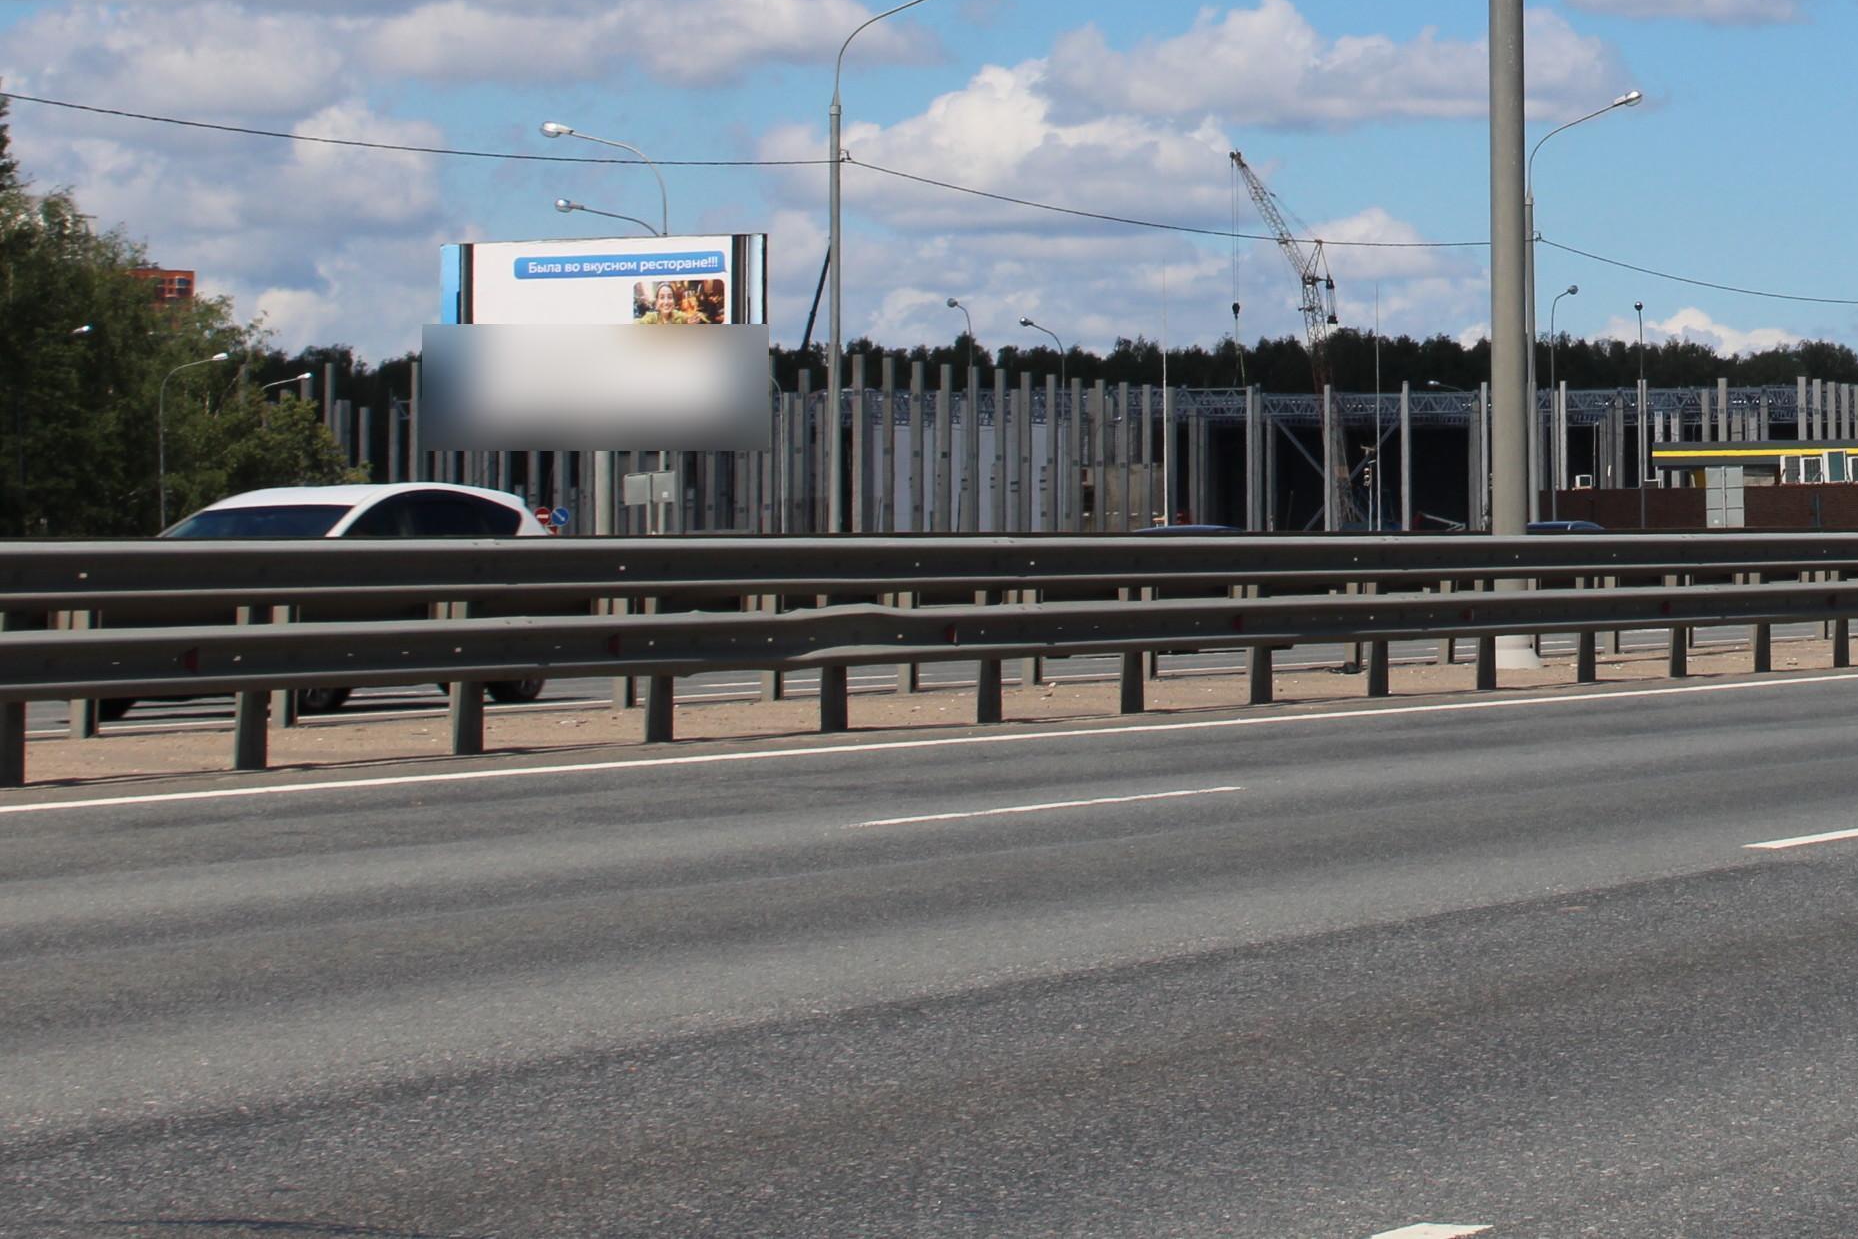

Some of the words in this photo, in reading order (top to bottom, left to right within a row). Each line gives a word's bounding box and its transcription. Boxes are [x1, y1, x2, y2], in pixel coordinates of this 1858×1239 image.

[528, 261, 562, 274] Была
[564, 262, 580, 273] во
[583, 261, 637, 275] вкусном
[640, 256, 719, 273] ресторане!!!
